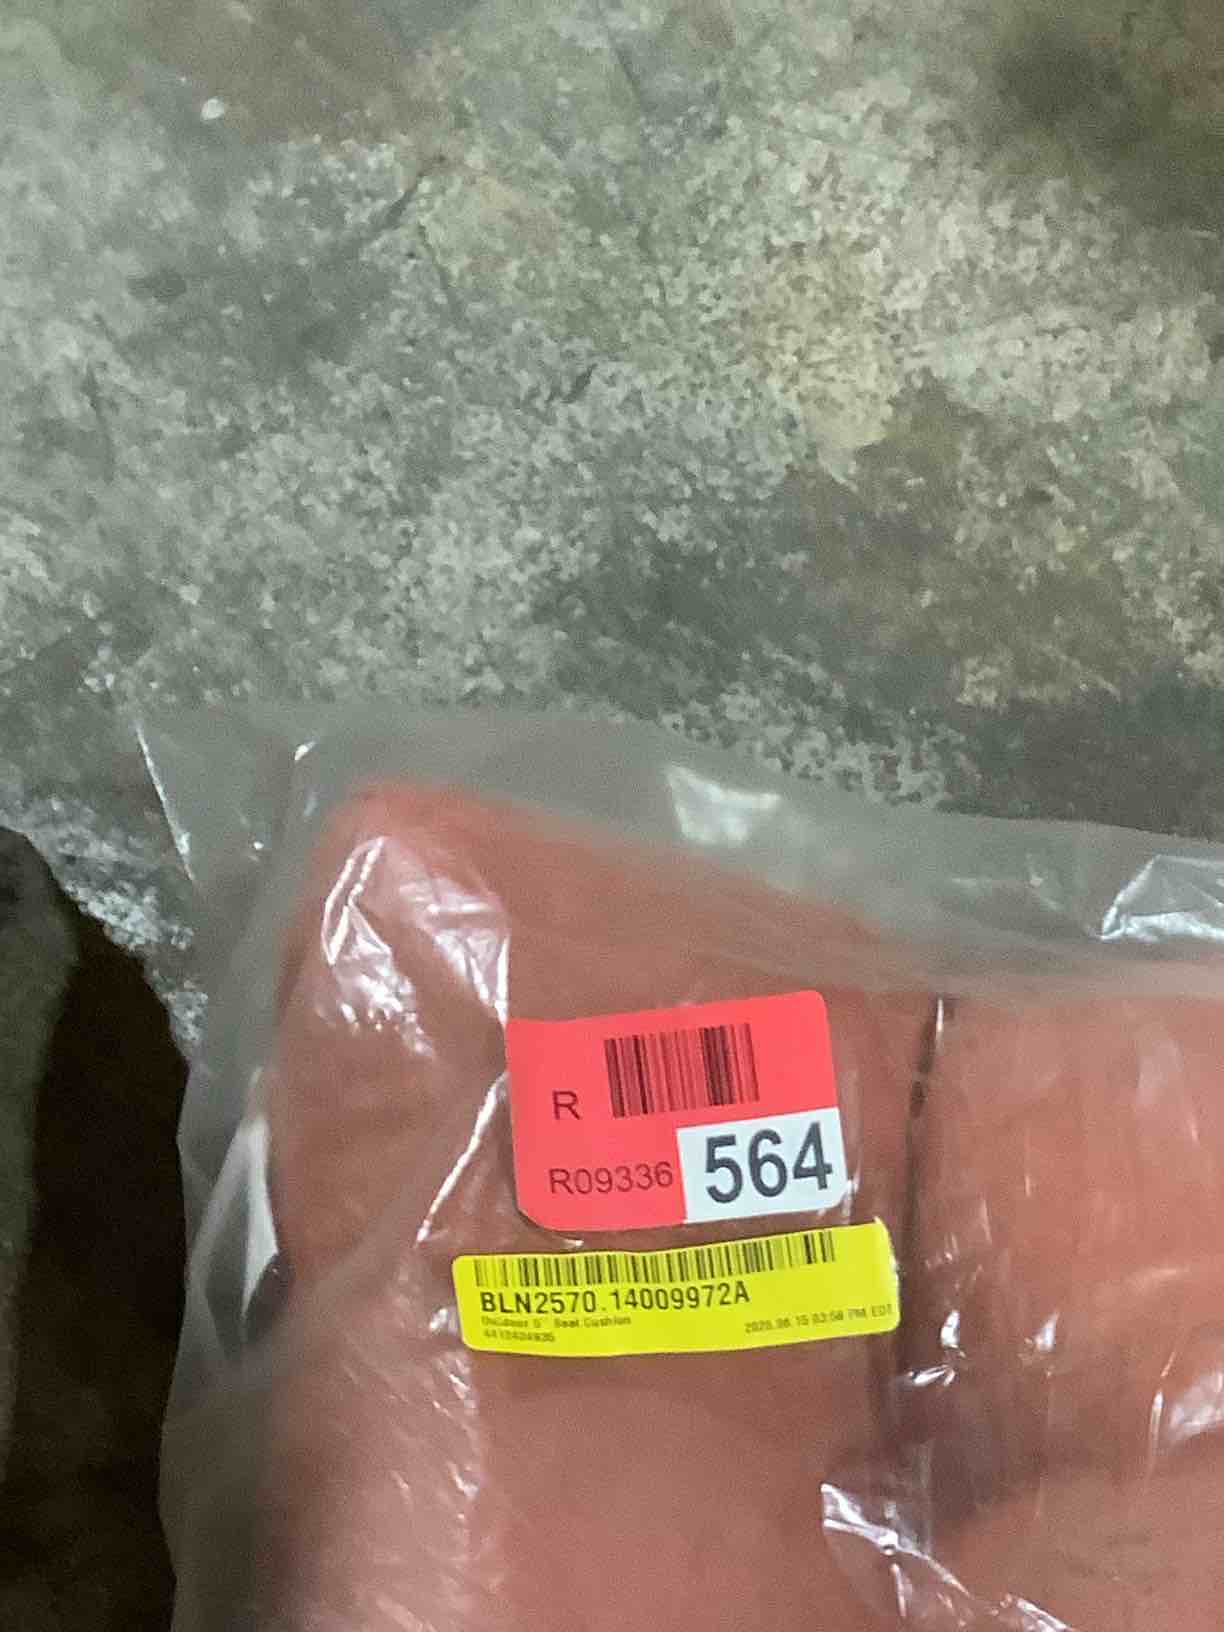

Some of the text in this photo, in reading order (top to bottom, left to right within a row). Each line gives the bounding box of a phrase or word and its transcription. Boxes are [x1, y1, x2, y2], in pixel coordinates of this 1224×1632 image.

[553, 1089, 582, 1121] R
[549, 1160, 674, 1195] R09336
[705, 1120, 834, 1204] 564
[480, 1281, 750, 1314] BLN2570.14009972A
[583, 1314, 631, 1327] Cushion
